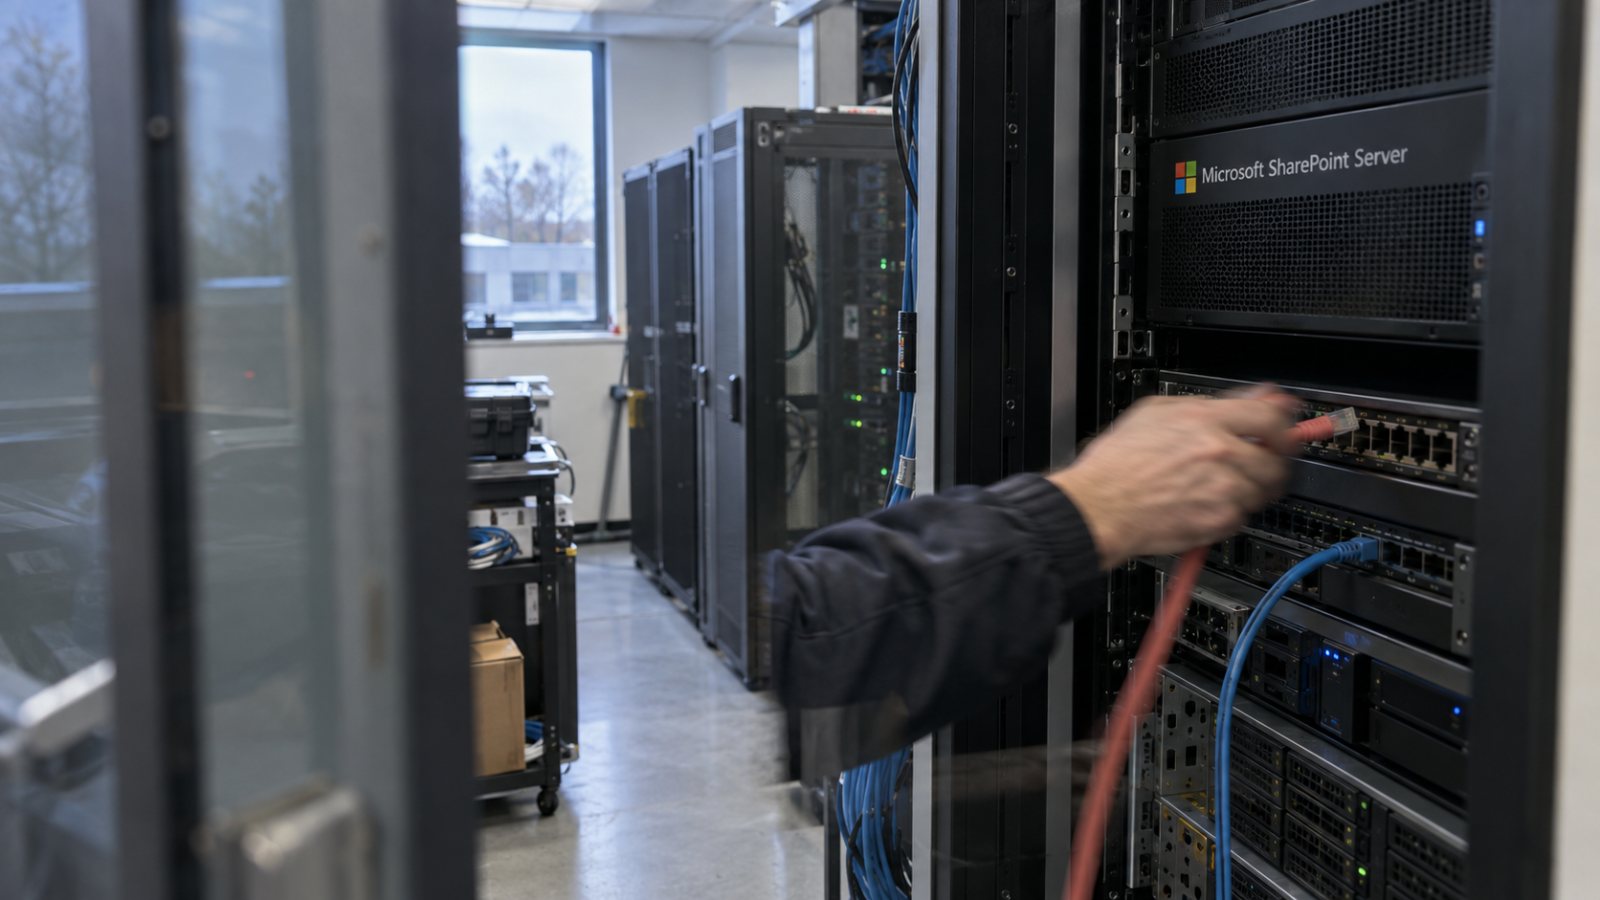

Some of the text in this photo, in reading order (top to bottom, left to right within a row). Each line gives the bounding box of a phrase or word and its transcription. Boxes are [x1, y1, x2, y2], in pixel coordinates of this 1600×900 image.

[1202, 147, 1408, 184] Microsoft SharePoint Server
